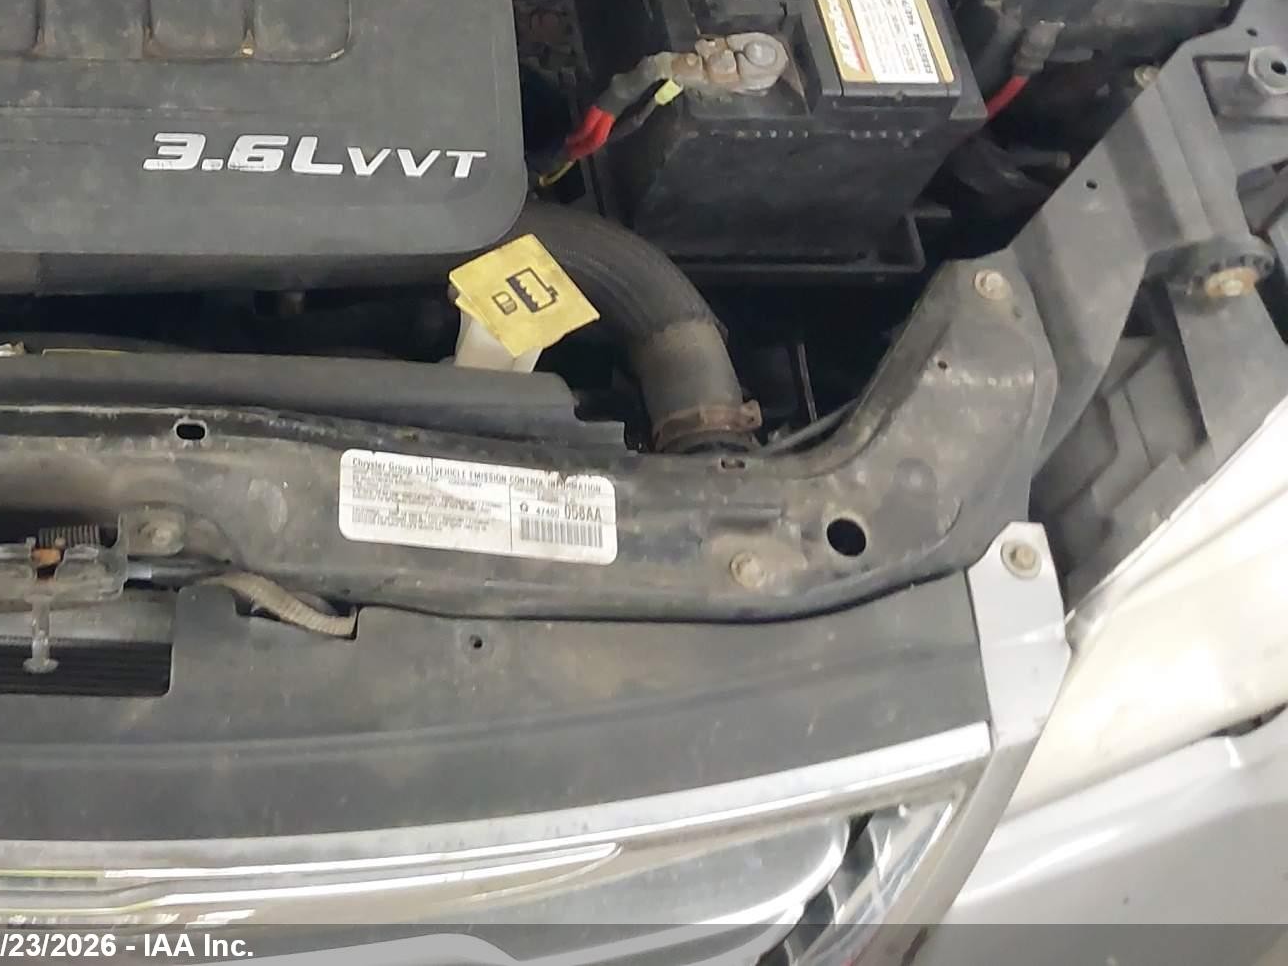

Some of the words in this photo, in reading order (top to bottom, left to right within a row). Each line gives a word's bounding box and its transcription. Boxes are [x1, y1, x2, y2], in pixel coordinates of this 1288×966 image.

[142, 132, 344, 175] 3.6L
[346, 146, 488, 179] VVT
[352, 458, 386, 472] Chrysler
[469, 472, 507, 483] EMISSION
